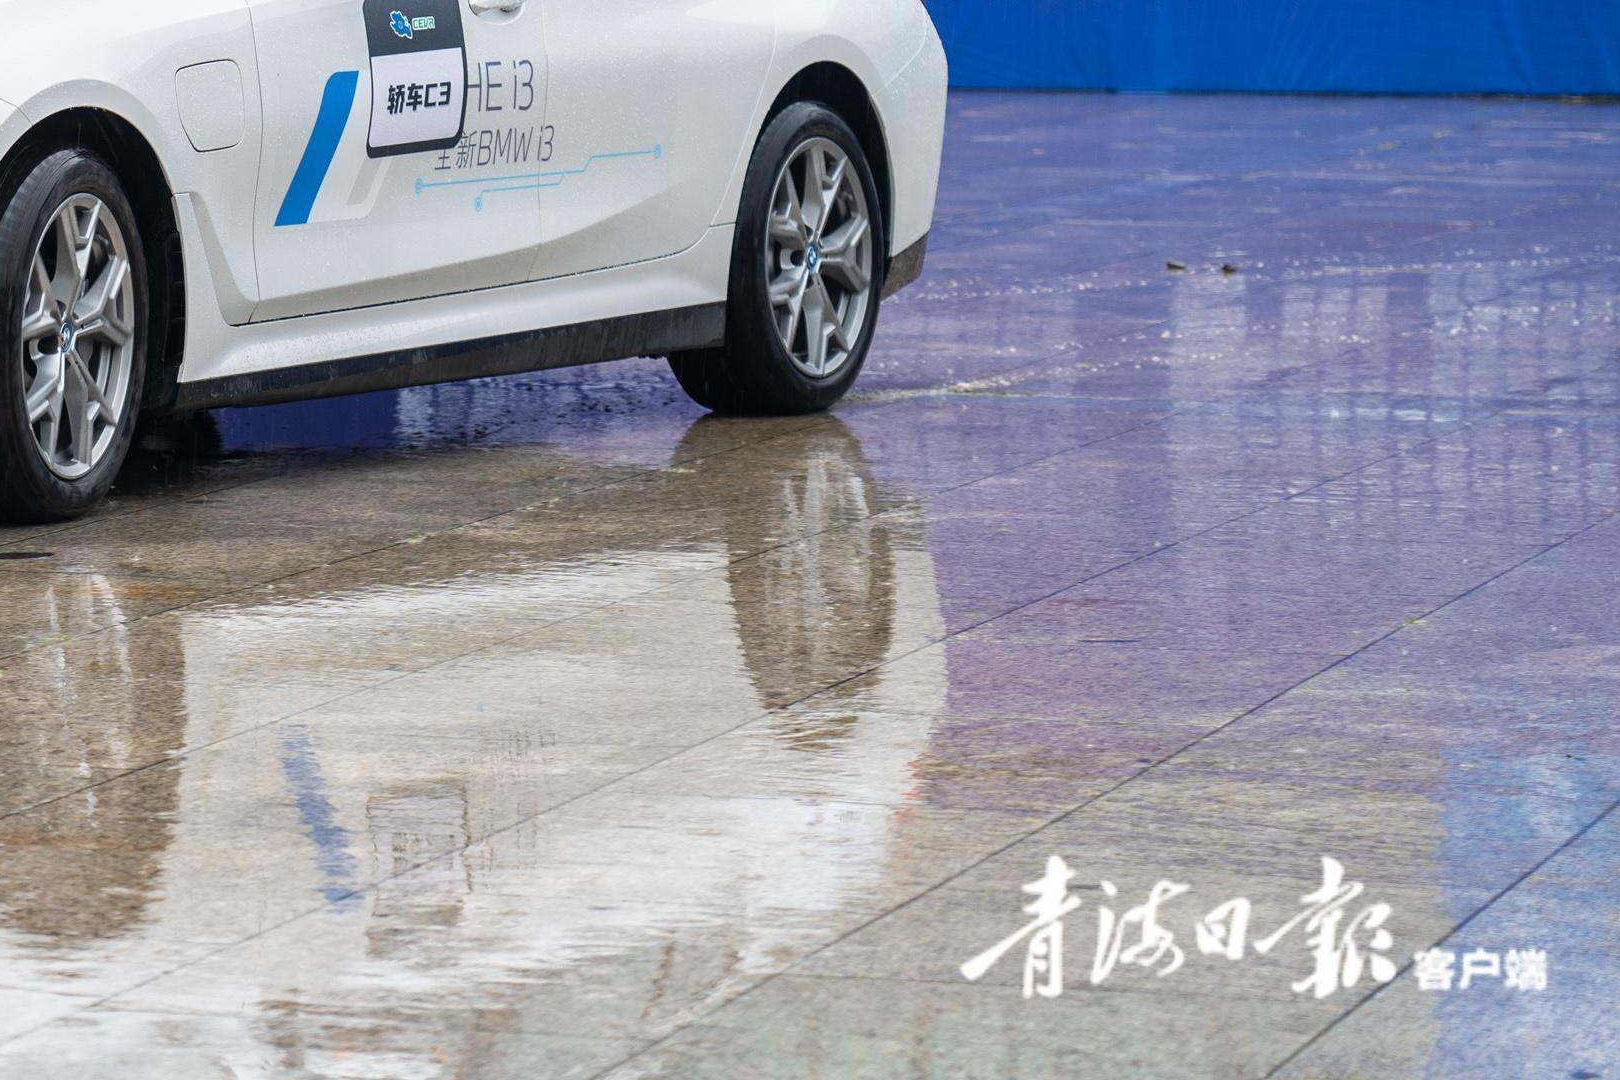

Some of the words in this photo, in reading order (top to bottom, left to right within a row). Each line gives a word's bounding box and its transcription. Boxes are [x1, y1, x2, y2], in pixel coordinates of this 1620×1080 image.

[412, 17, 435, 30] CEVR
[387, 81, 452, 115] 轿车C3
[512, 59, 534, 111] i3
[537, 125, 555, 162] i3
